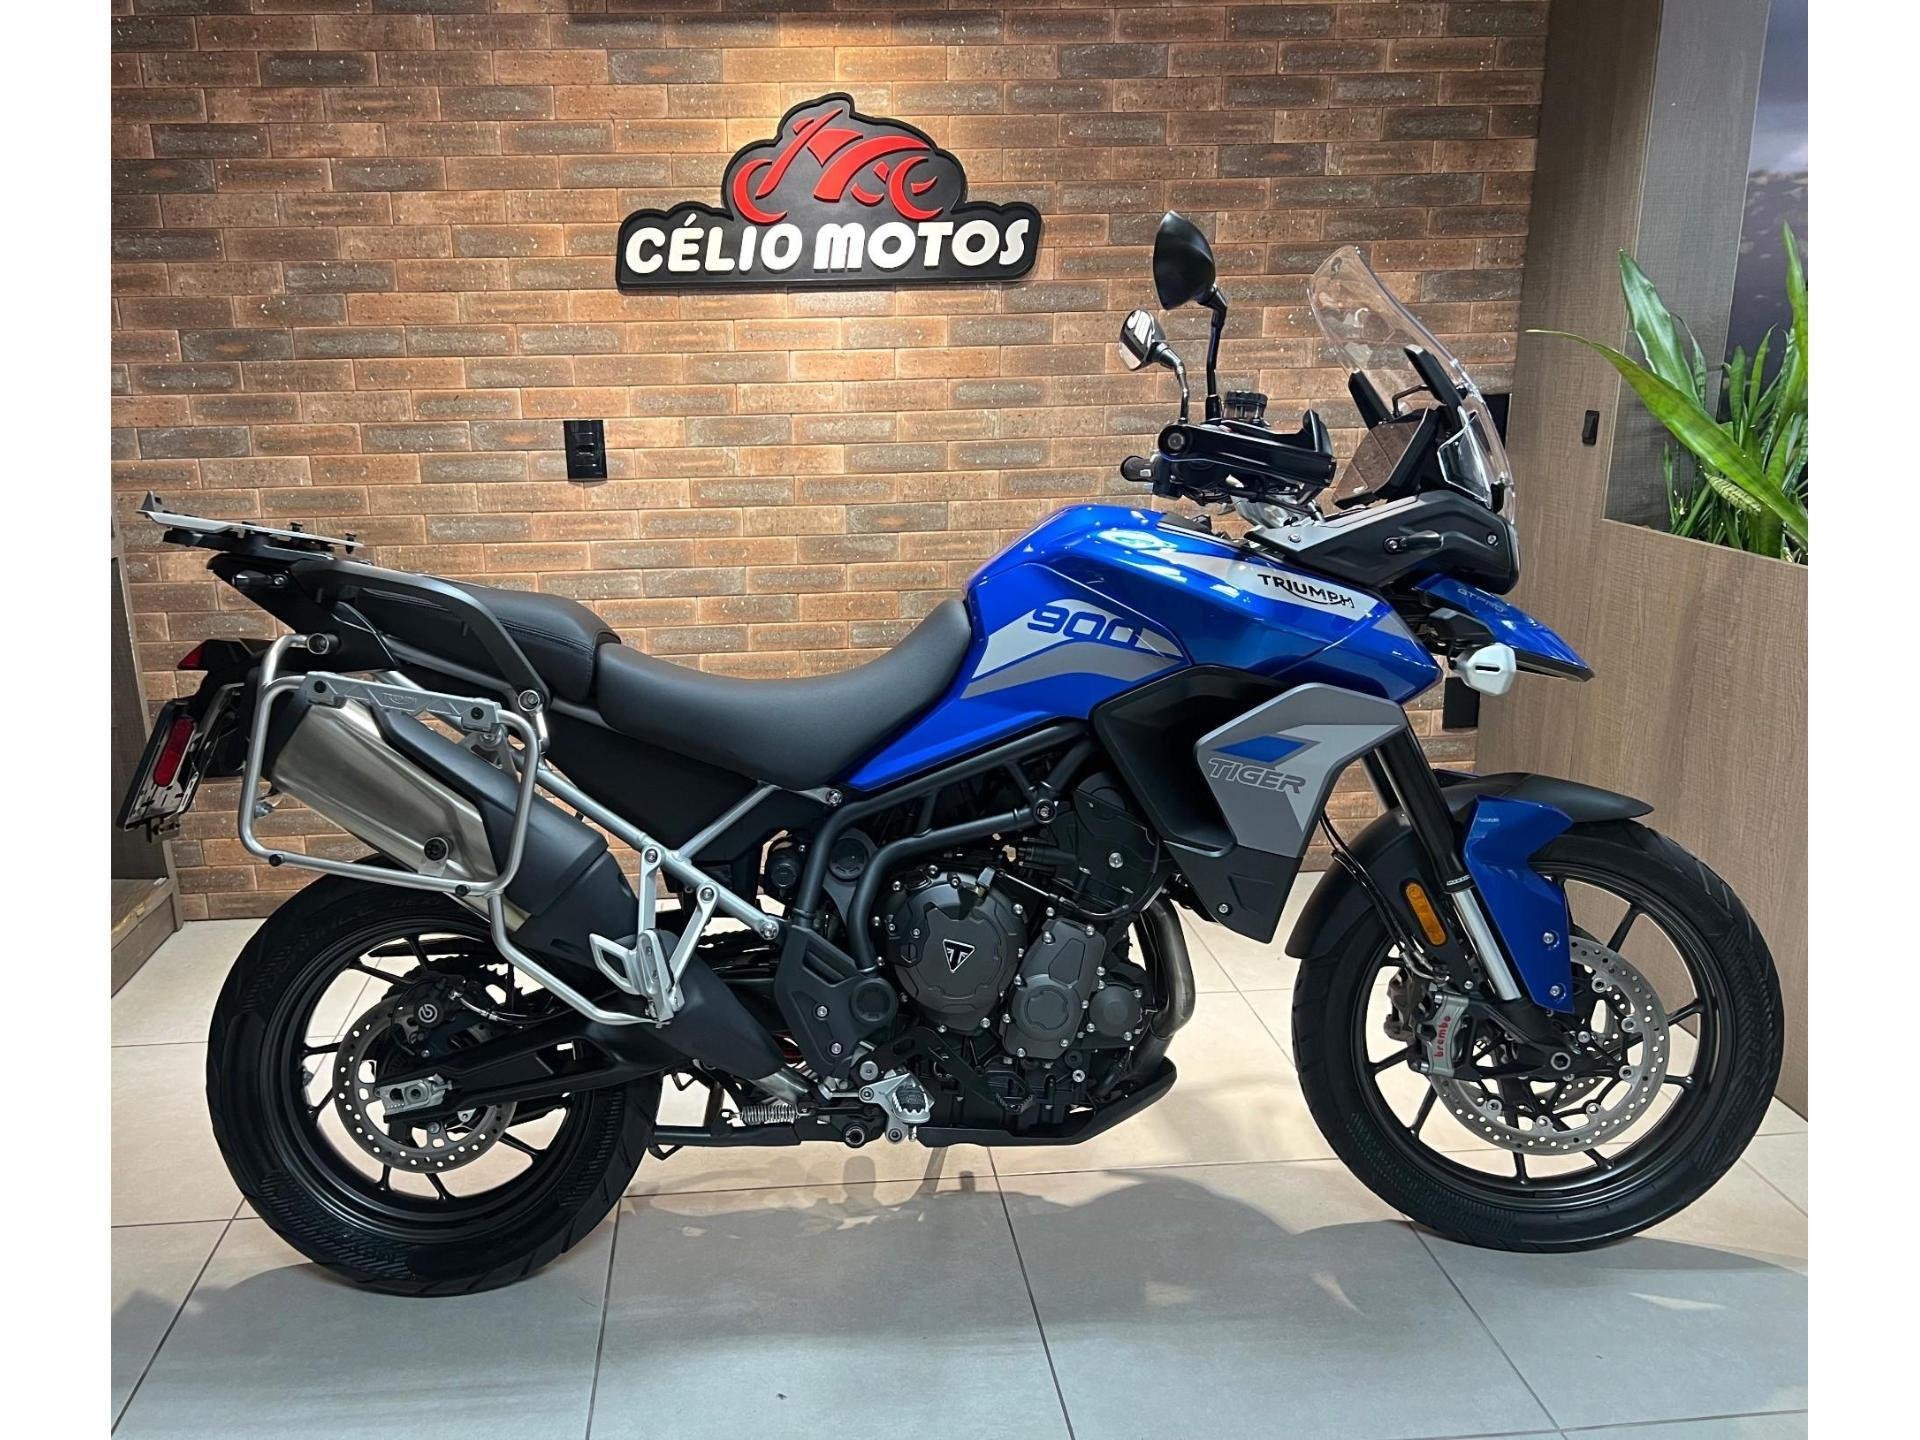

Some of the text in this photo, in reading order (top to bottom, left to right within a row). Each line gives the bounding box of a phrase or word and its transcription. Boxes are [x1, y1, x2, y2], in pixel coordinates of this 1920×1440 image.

[625, 213, 1029, 274] CÉLIO MOTOS
[1257, 574, 1355, 608] TRIUMPH
[1027, 605, 1142, 648] 900
[1208, 757, 1307, 794] TIGER
[1434, 1015, 1451, 1057] brembo
